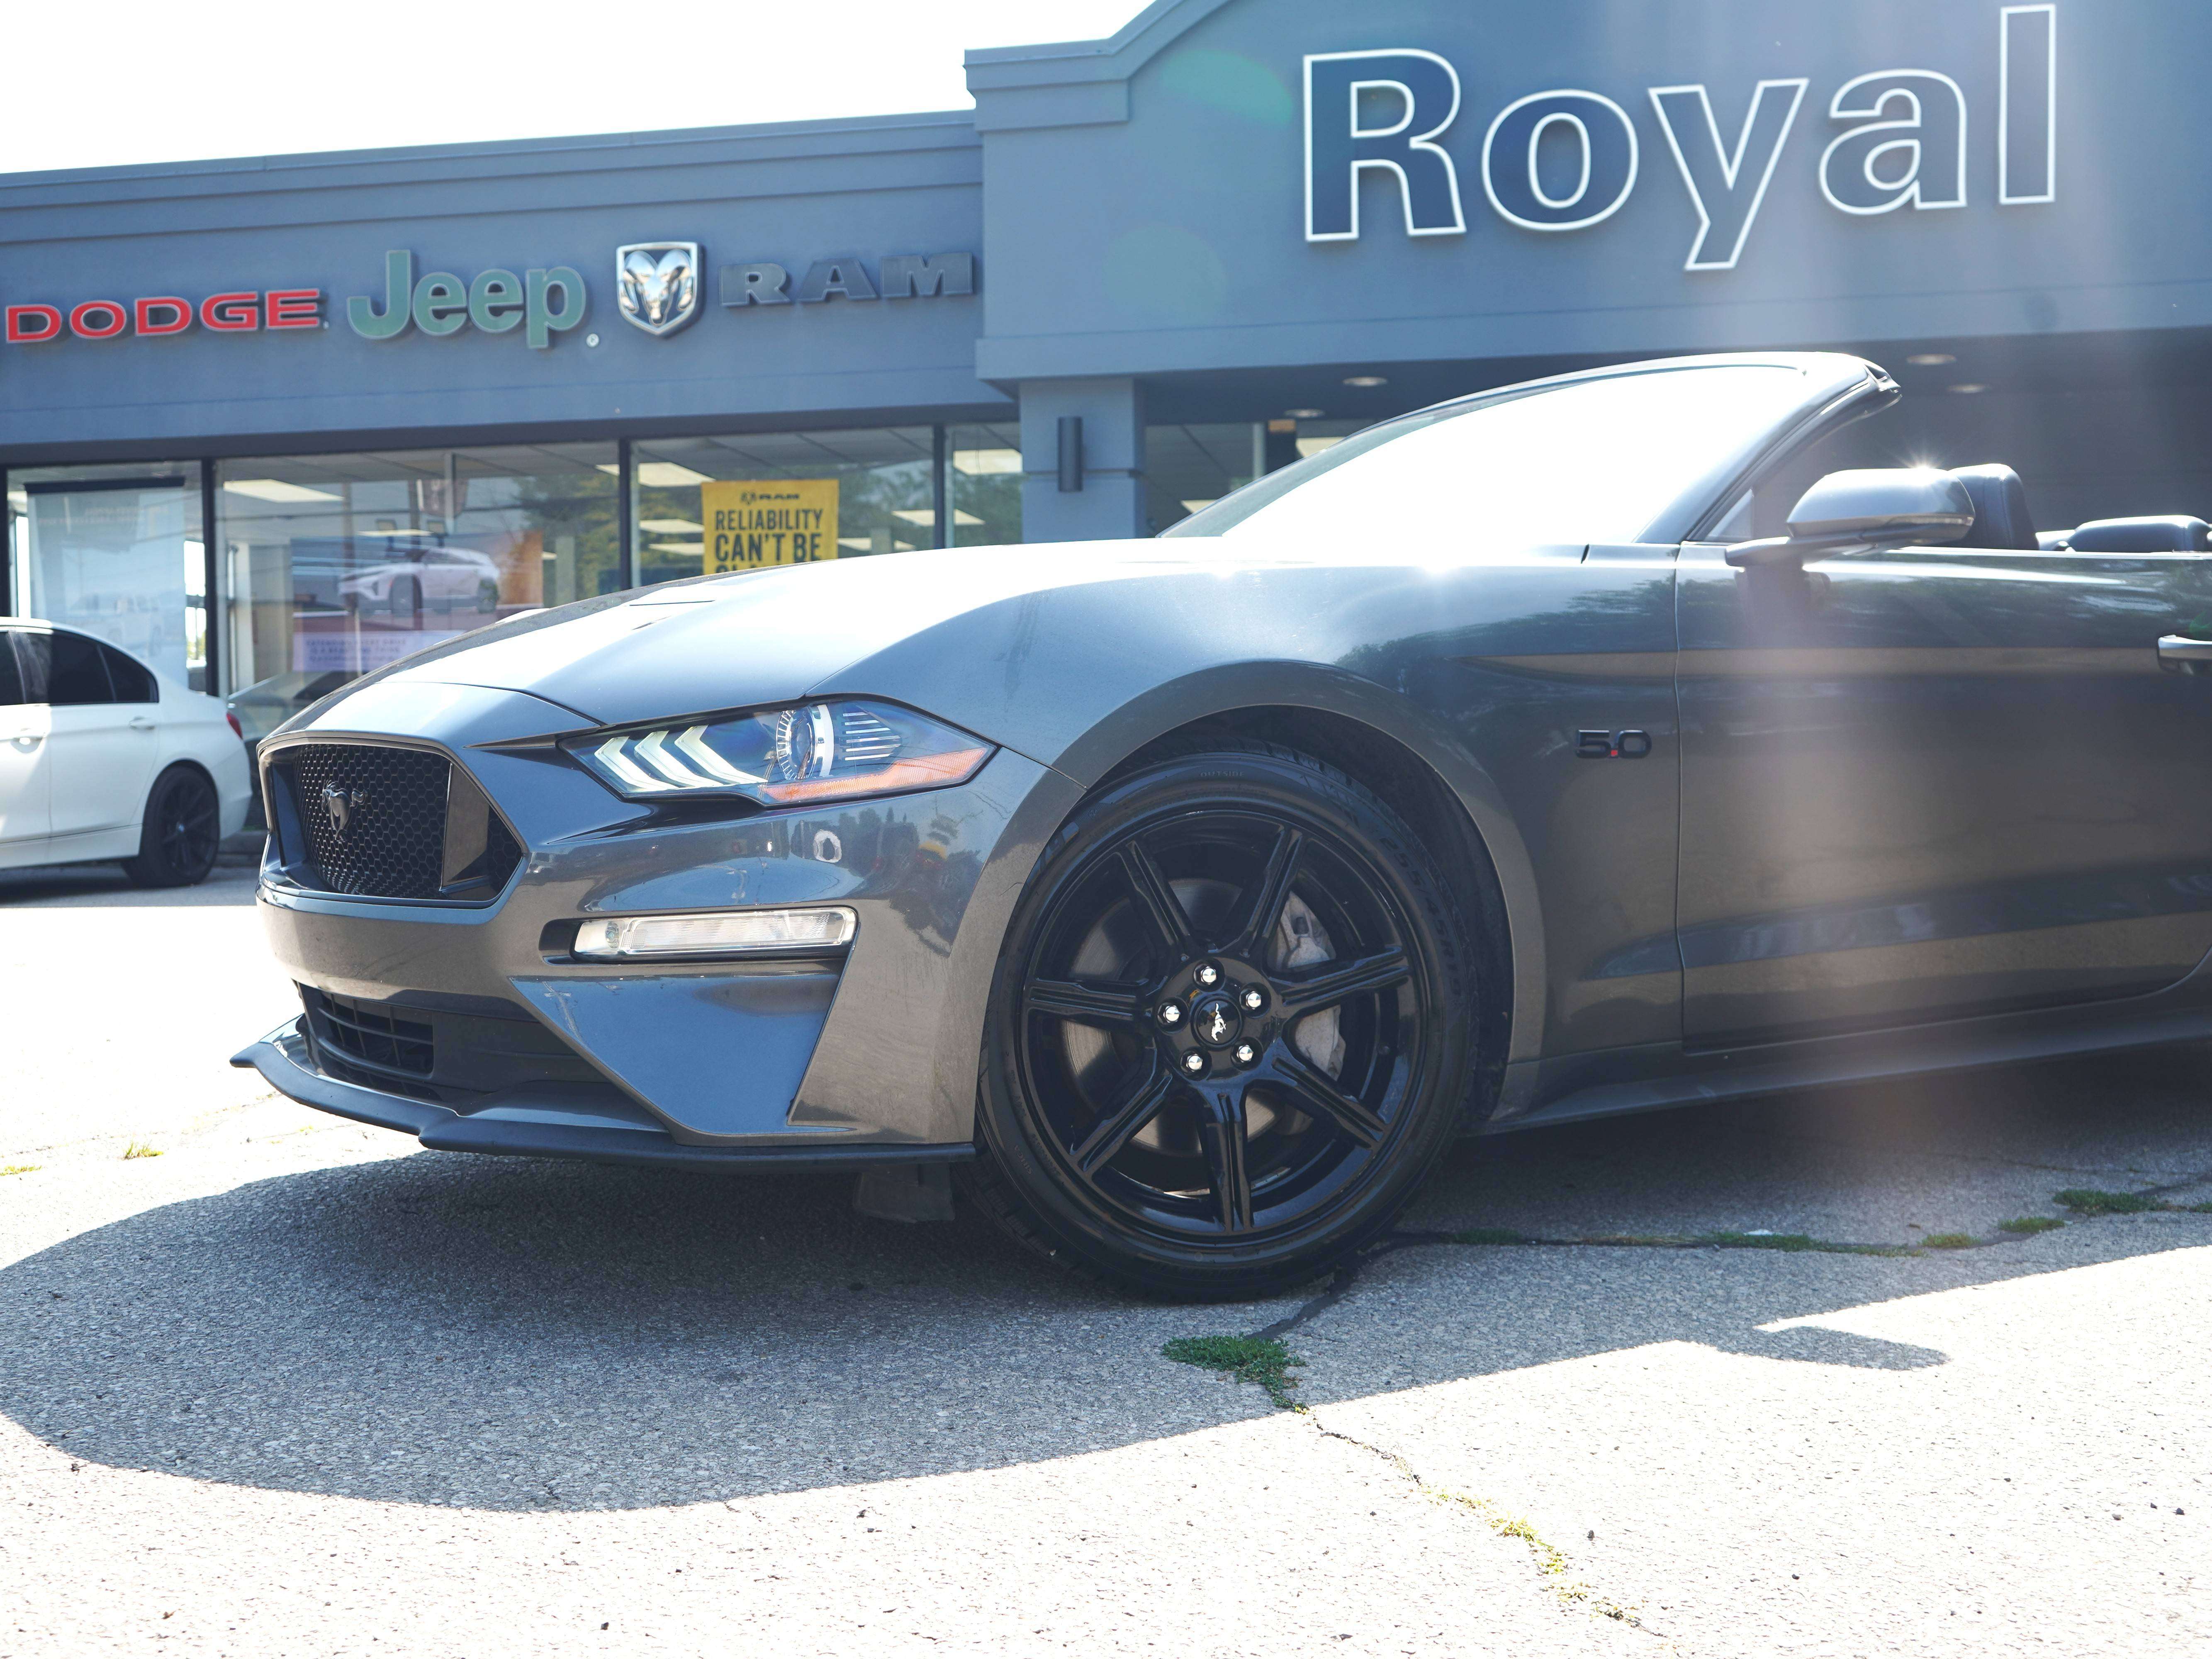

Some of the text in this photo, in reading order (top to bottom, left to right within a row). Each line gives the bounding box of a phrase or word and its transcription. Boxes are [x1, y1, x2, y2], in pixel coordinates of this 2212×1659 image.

[1302, 2, 2057, 271] Royal
[347, 249, 586, 349] Jeep
[718, 251, 973, 307] RAM
[6, 288, 321, 343] DODGE
[715, 509, 823, 531] RELIABILITY
[715, 533, 823, 562] CAN'T BE
[1575, 729, 1652, 759] 5.0
[1013, 1144, 1032, 1175] SILICA
